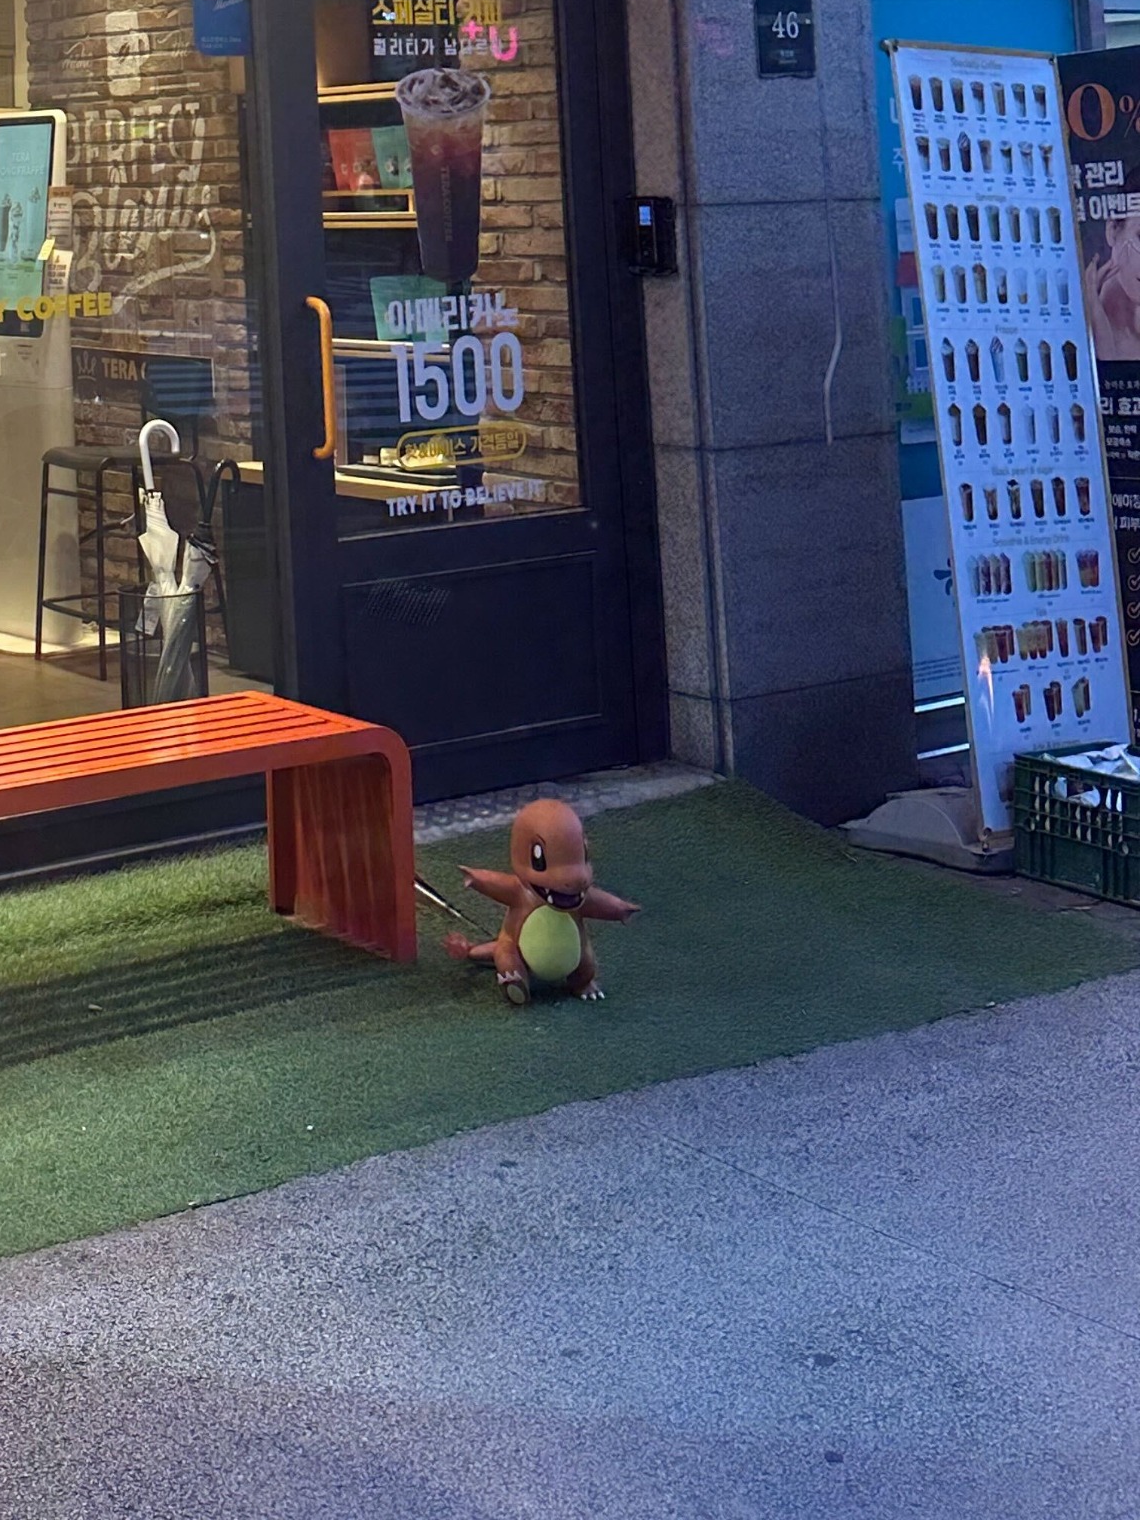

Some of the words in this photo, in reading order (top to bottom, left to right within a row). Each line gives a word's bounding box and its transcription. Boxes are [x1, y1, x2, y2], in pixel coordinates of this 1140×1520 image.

[771, 11, 799, 38] 46
[373, 36, 435, 57] 퀄리티가
[1085, 160, 1124, 189] 관리
[16, 291, 113, 322] COFFEE
[388, 292, 519, 334] 아메리카노
[101, 358, 137, 381] TERA
[390, 331, 524, 424] 1500
[386, 497, 416, 518] TRY
[421, 492, 437, 513] IT
[440, 490, 464, 511] TO
[465, 482, 525, 507] BELIEVE
